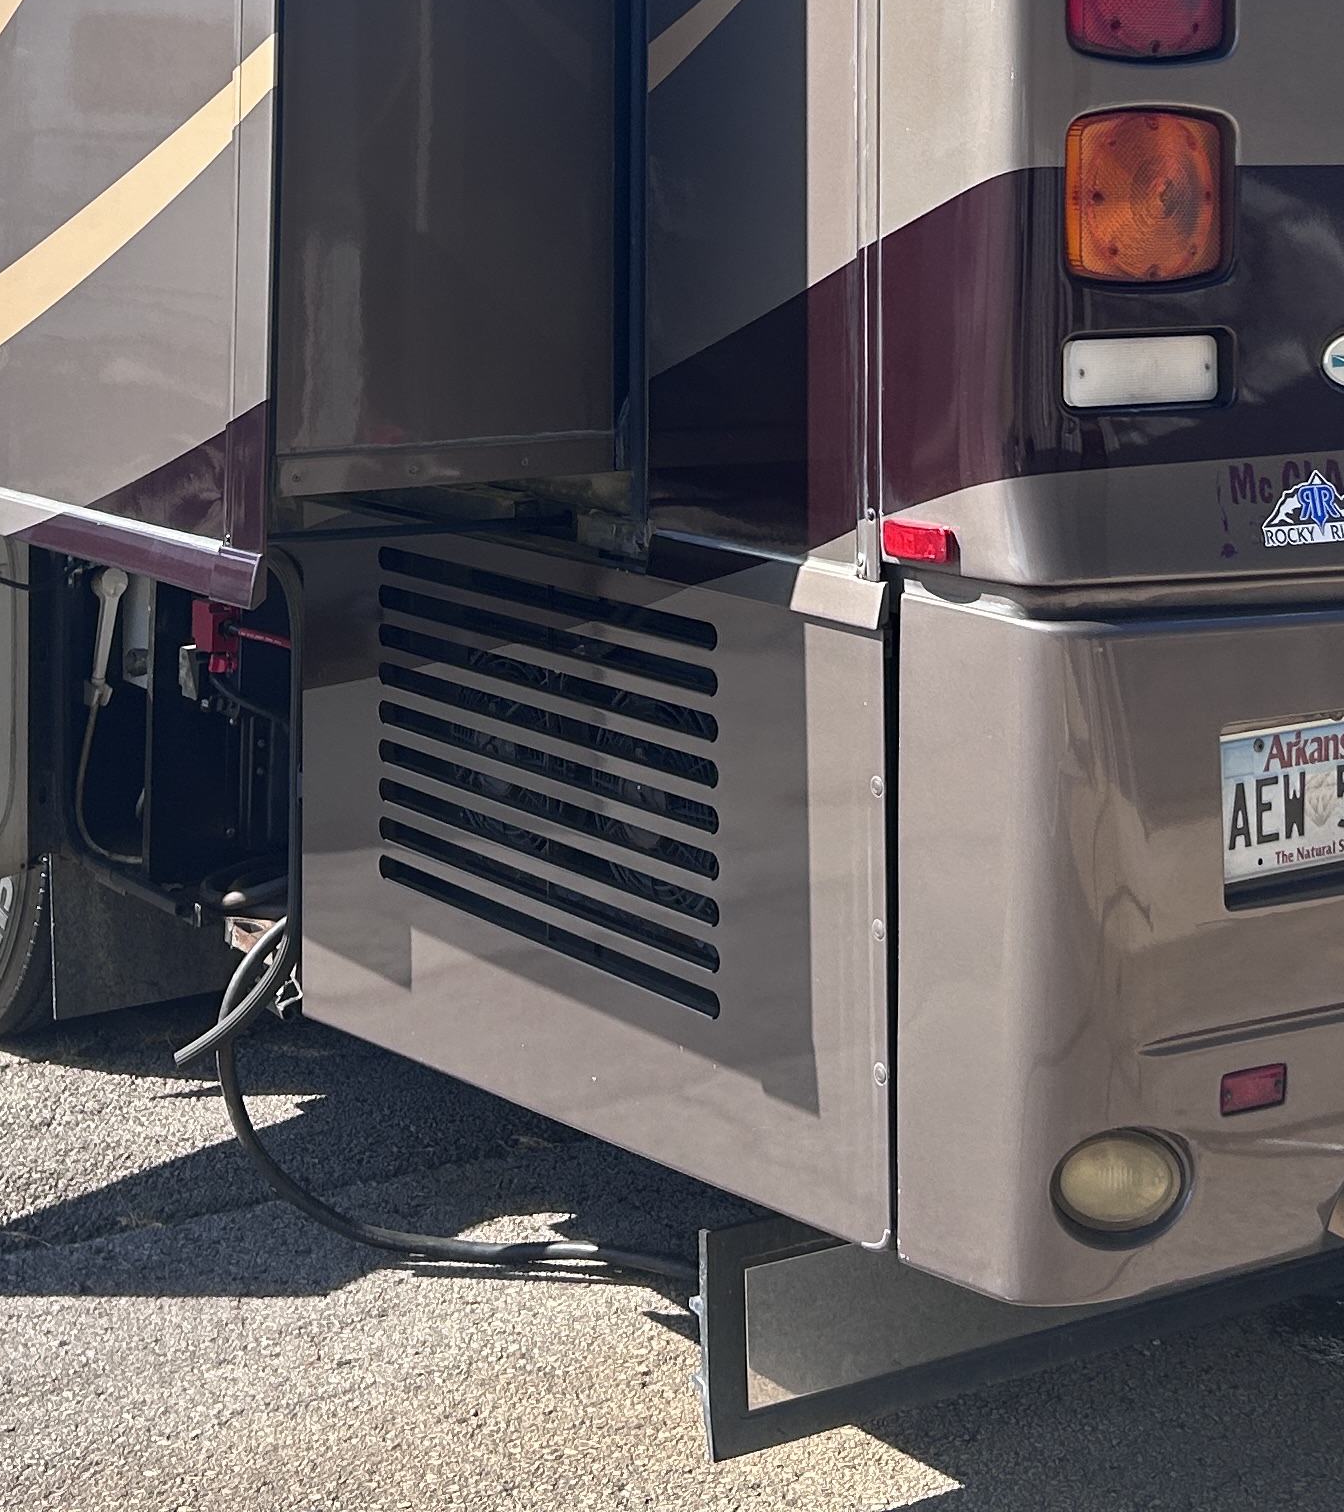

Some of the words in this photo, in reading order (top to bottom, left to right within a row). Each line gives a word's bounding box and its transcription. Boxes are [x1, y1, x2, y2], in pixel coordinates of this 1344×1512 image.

[1264, 525, 1316, 546] ROCKY
[1228, 771, 1306, 850] AEW
[1275, 849, 1294, 865] The
[1295, 840, 1337, 860] Natural
